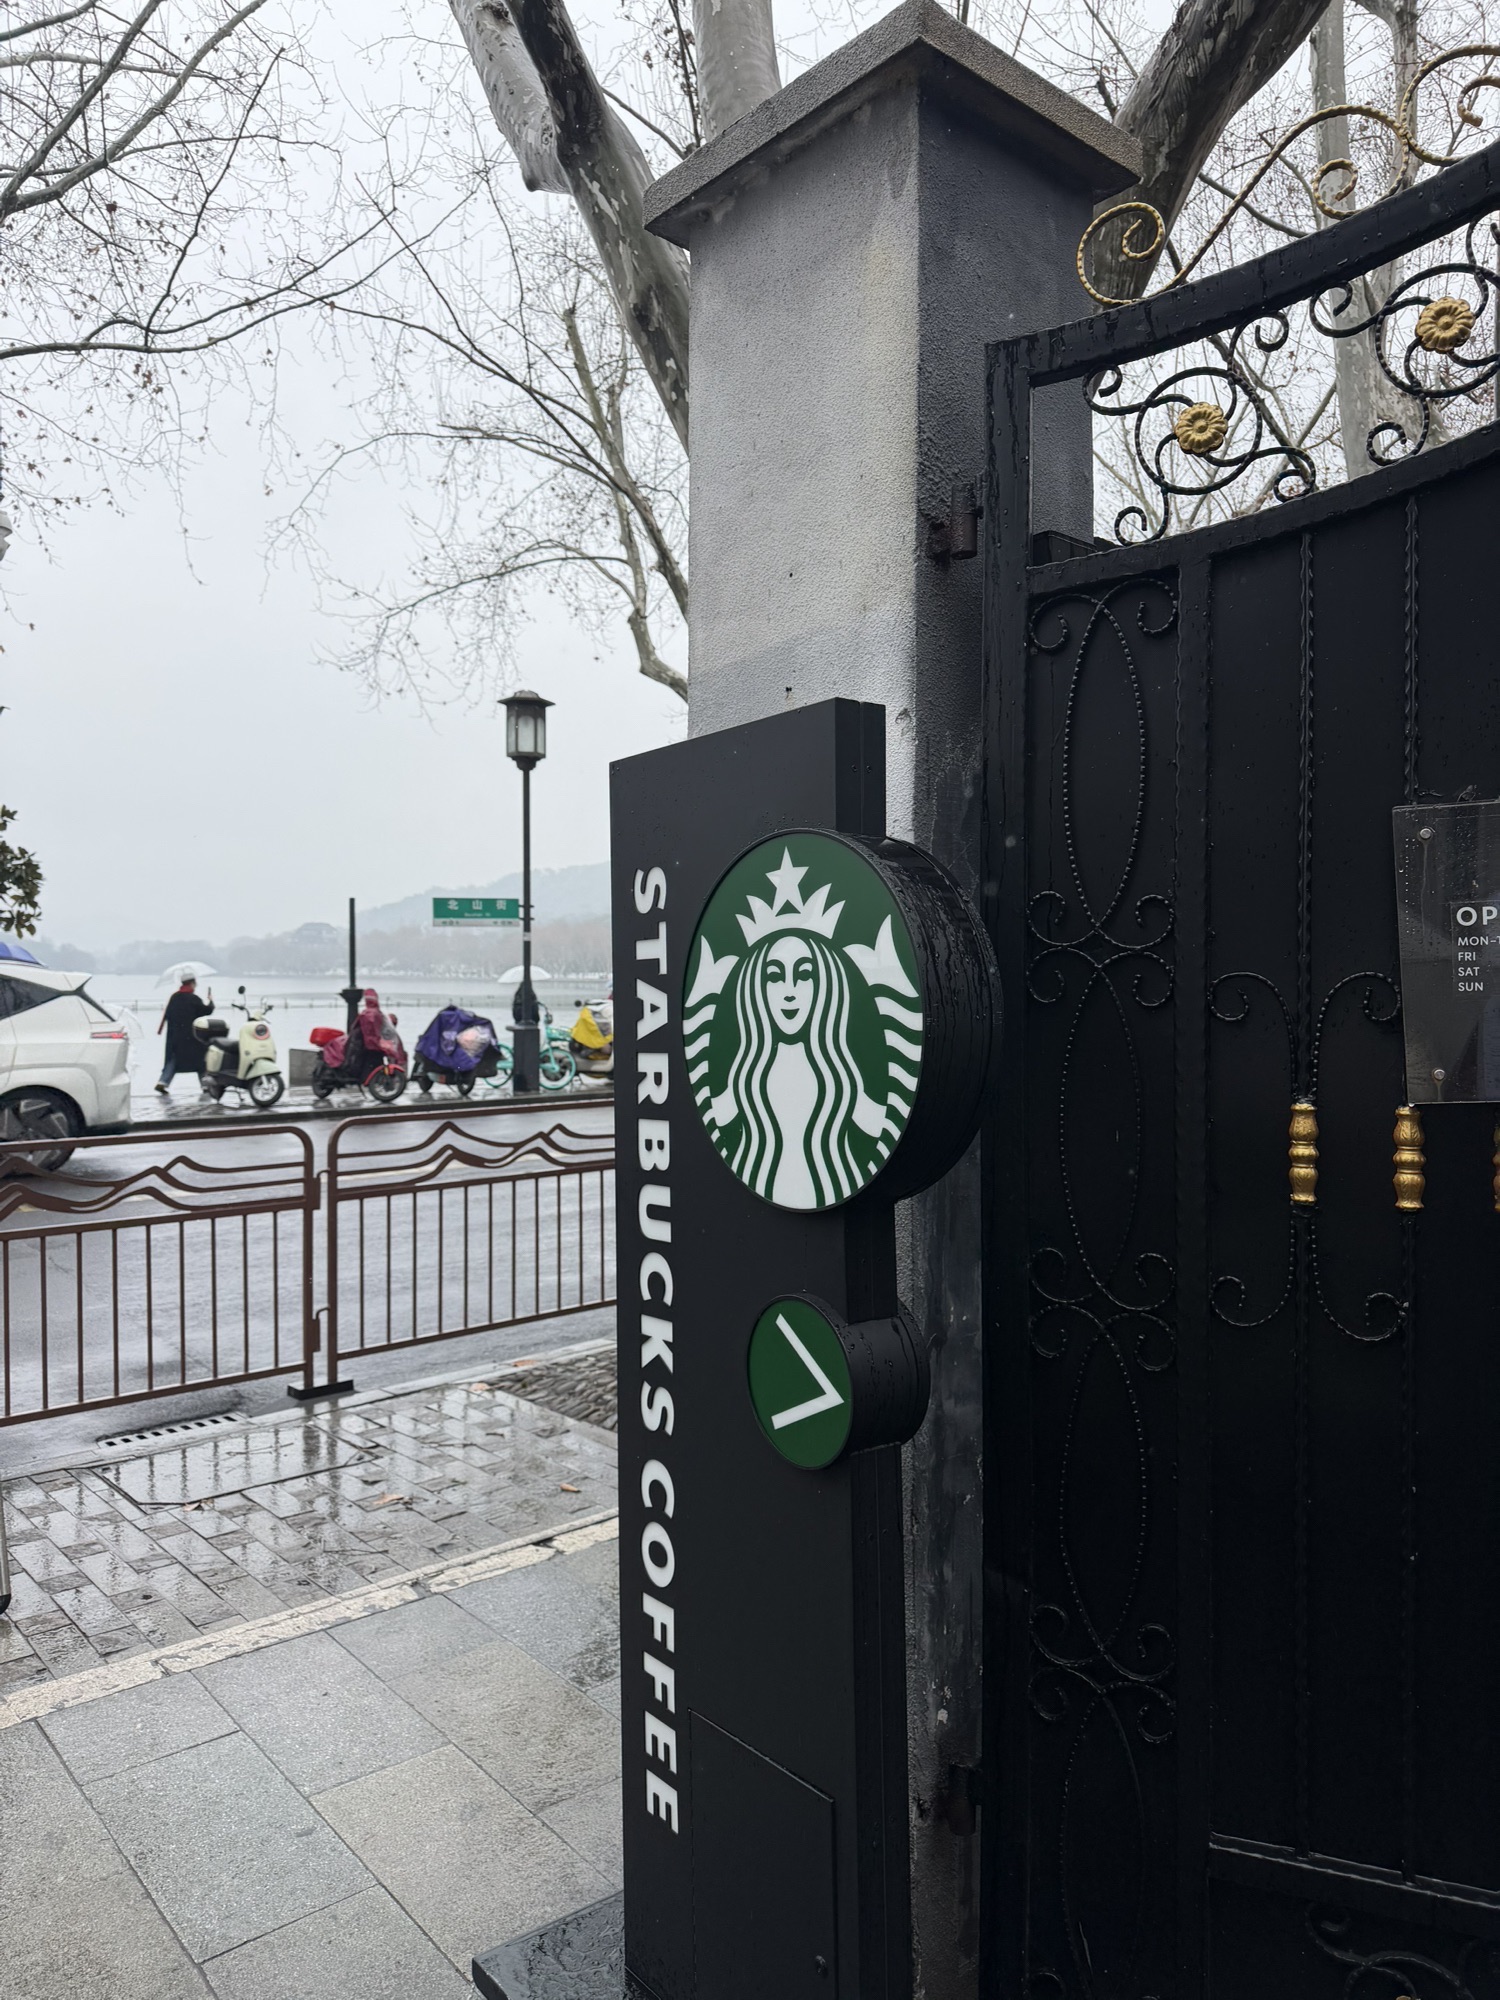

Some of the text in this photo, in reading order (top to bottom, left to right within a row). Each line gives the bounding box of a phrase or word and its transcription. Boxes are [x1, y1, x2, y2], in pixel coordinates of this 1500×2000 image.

[1458, 952, 1476, 961] FRI
[1458, 967, 1480, 977] SAT
[1458, 982, 1483, 992] SUN
[634, 866, 679, 1834] STARBUCKS COFFEE
